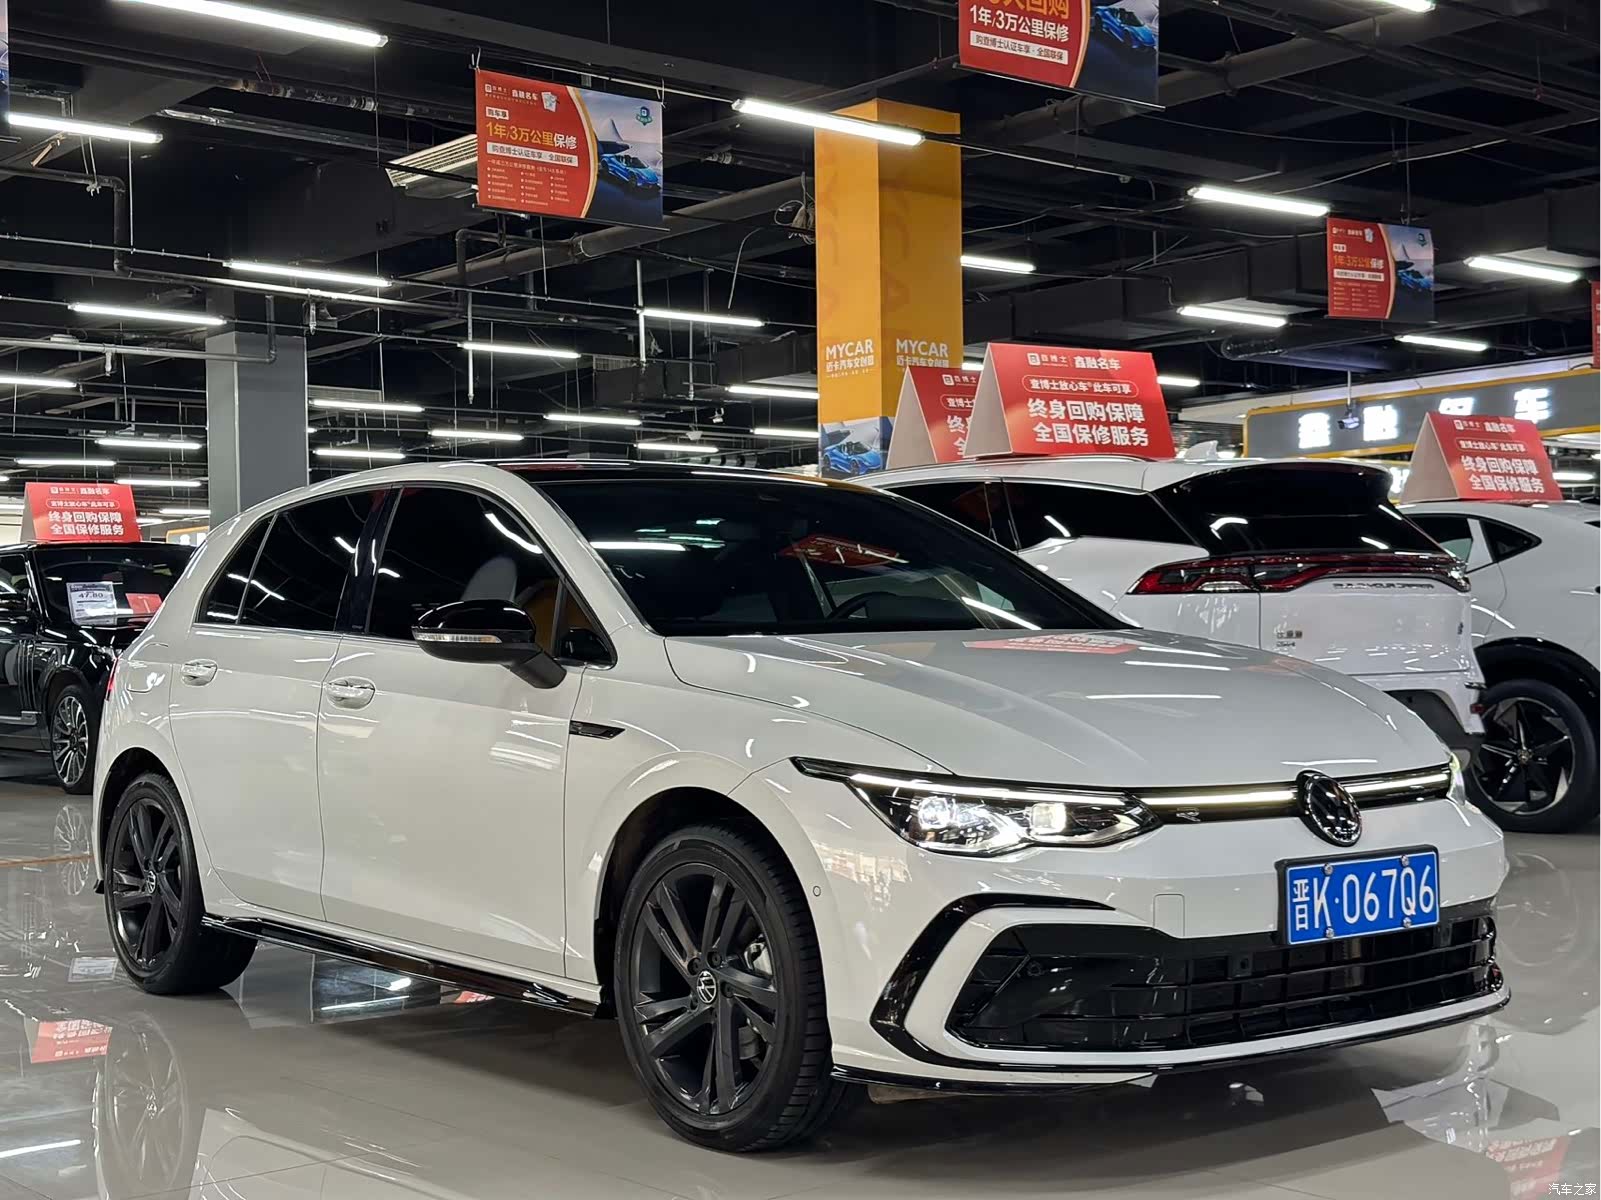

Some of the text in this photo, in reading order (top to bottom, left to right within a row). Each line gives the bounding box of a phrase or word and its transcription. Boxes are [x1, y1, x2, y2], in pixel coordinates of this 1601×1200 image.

[970, 4, 1069, 42] 1年/3万公里保修
[486, 121, 577, 149] 1年/3万公里保修
[826, 339, 874, 361] MYCAR
[896, 338, 949, 358] MYCAR
[1074, 356, 1122, 370] 鑫融名车
[1027, 398, 1145, 423] 终身回购保障
[1033, 422, 1149, 446] 全国保修服务
[1461, 455, 1539, 475] 终身回购保障
[1469, 474, 1544, 493] 全国保修服务
[48, 511, 122, 523] 终身回购保障
[50, 524, 124, 535] 全国保修服务
[1292, 865, 1434, 931] 晋K·067Q6
